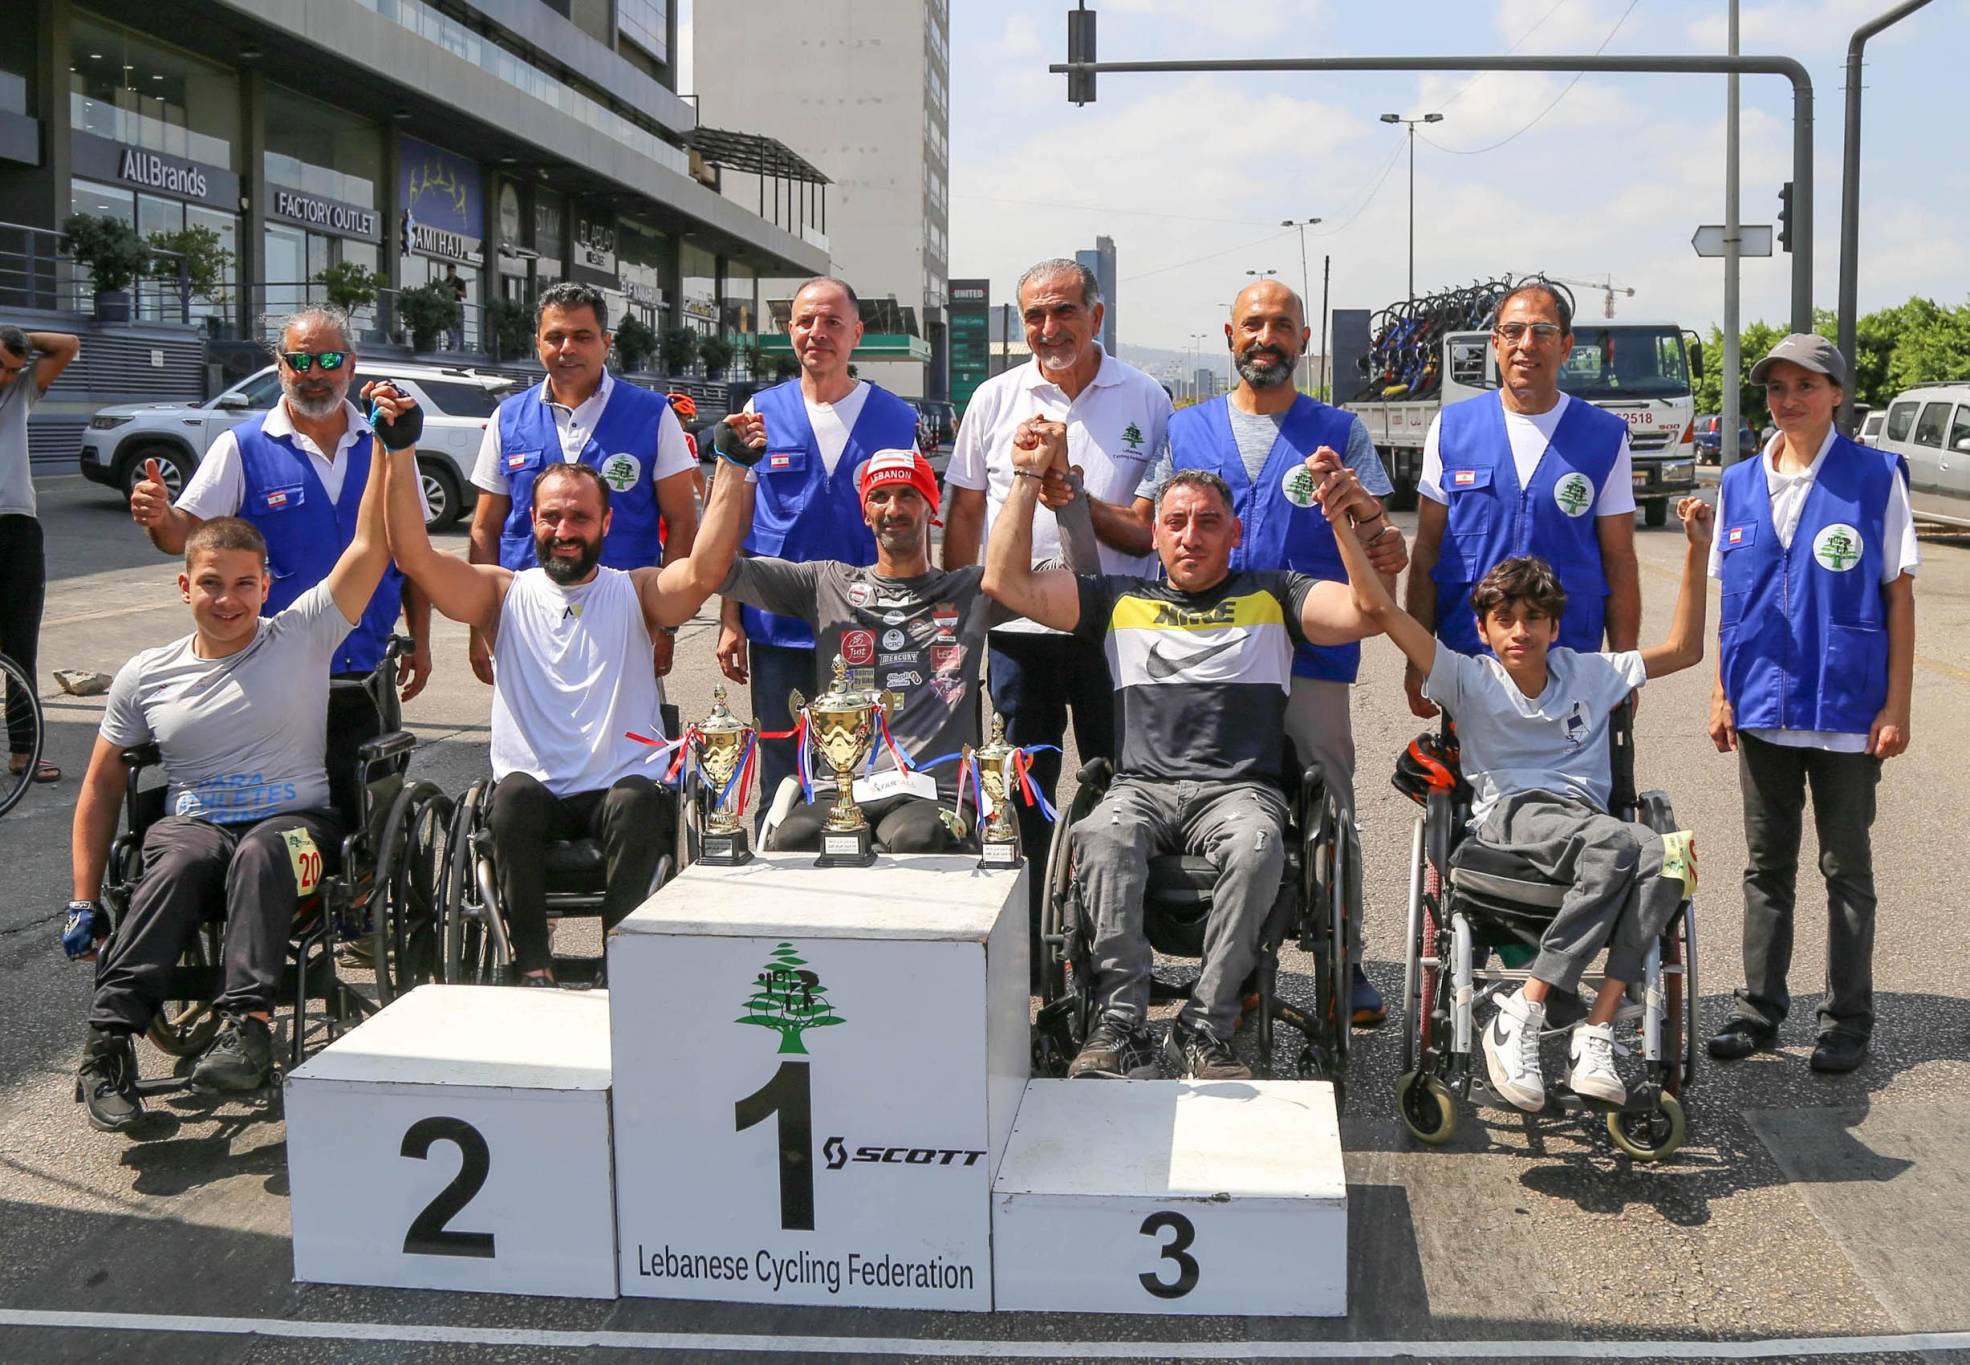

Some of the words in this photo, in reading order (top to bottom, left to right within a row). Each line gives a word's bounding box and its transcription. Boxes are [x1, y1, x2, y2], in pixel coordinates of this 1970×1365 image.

[122, 149, 207, 197] AllBrands
[278, 192, 332, 225] FACTORY
[334, 208, 375, 236] OUTLET
[439, 230, 465, 258] HAJJ
[954, 289, 984, 299] UNITED
[1615, 411, 1653, 425] 2518
[870, 469, 912, 484] LEBANON
[882, 652, 918, 664] MERCURY
[299, 851, 320, 888] 20
[735, 1061, 815, 1231] 1
[852, 1147, 988, 1167] SCOTT
[400, 1116, 496, 1259] 2
[638, 1244, 749, 1281] Lebanese
[755, 1249, 841, 1294] Cycling
[848, 1252, 975, 1290] Federation
[1138, 1210, 1200, 1299] 3
